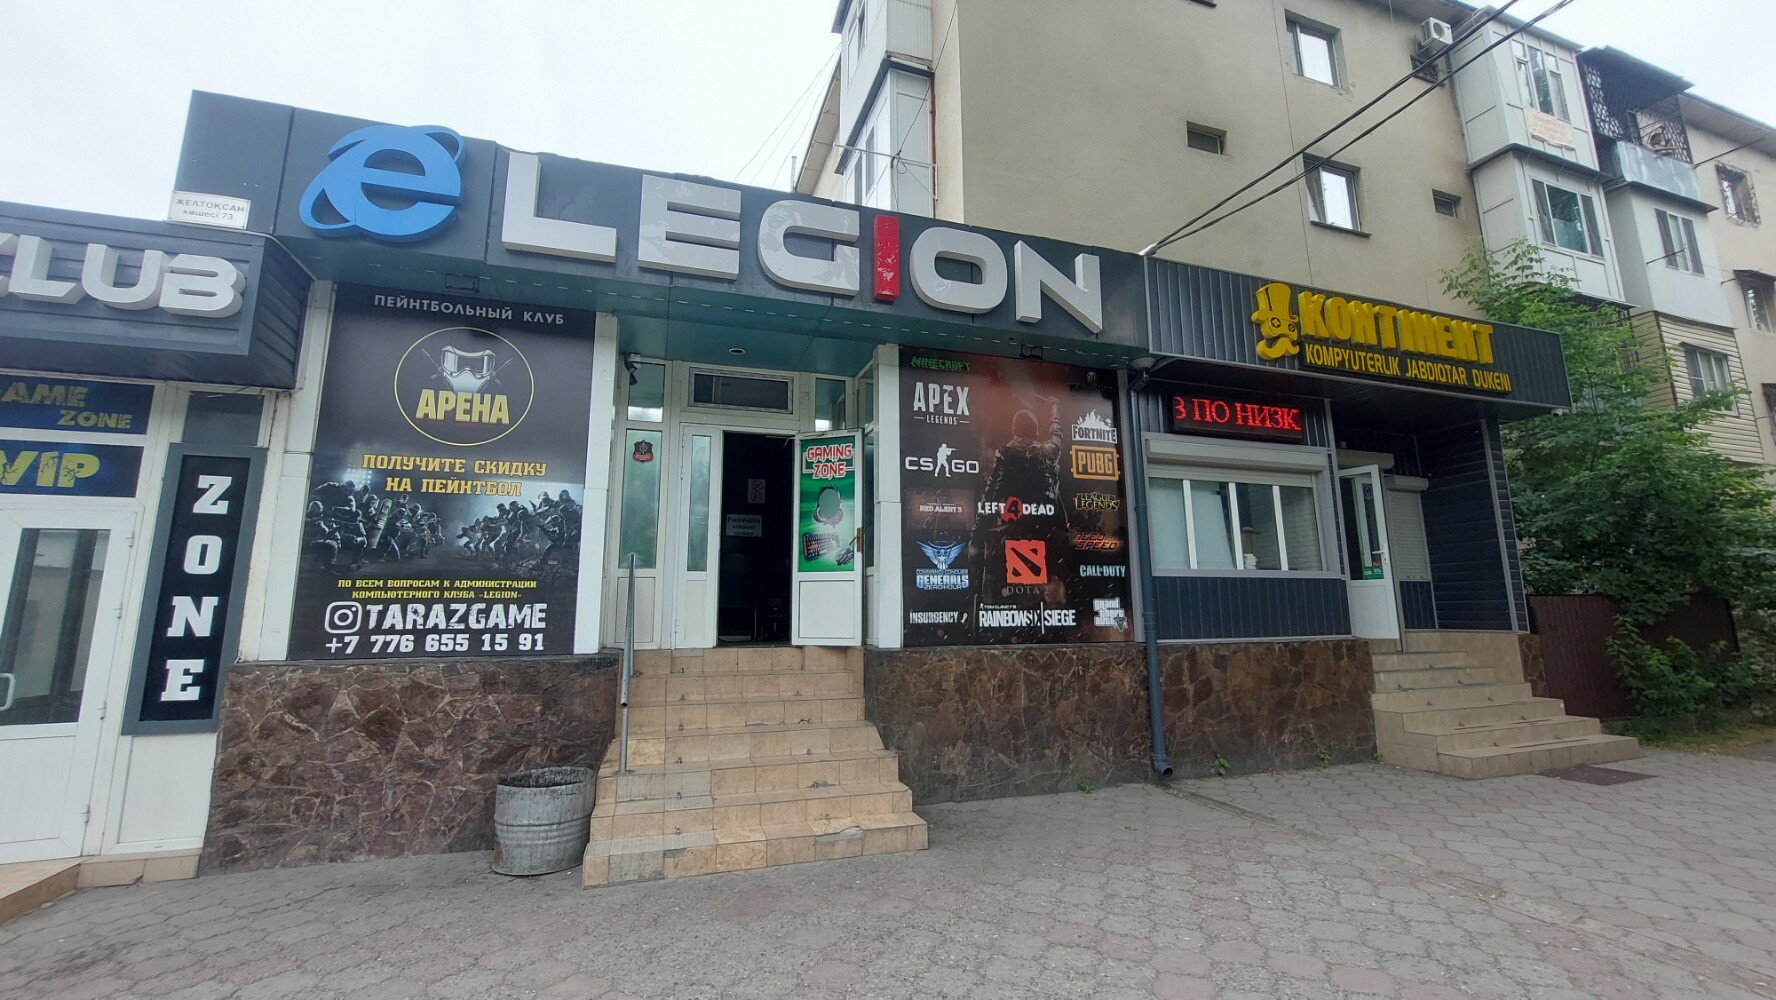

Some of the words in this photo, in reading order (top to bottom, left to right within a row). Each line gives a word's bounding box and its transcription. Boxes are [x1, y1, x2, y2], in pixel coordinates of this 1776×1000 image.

[222, 212, 234, 220] 73
[501, 151, 1103, 334] LEGION
[374, 294, 513, 321] ПЕЙНТБОЛЬНЫЙ
[523, 311, 565, 325] КЛУБ
[1305, 343, 1401, 376] KOMPYUTERLIK
[1405, 358, 1468, 386] JABDIQTAR
[1472, 368, 1512, 392] DUKENI
[415, 388, 511, 425] АРЕНА
[913, 382, 970, 416] APEX
[57, 409, 133, 429] ZONE
[926, 414, 958, 425] LEGENDS
[1191, 398, 1231, 423] ПО
[1234, 402, 1302, 430] НИЗК
[1072, 425, 1117, 443] FORTNITE
[806, 443, 853, 462] GAMING
[0, 449, 101, 489] VIP
[362, 454, 466, 473] ПОЛУЧИТЕ
[474, 460, 547, 477] СКИДКУ
[812, 462, 846, 479] ZONE
[1077, 451, 1113, 475] PUBG
[385, 477, 412, 493] НА
[421, 476, 523, 497] ПЕЙНТБОЛ
[977, 501, 1006, 515] LEFT
[1022, 502, 1055, 516] DEAD
[1073, 498, 1120, 511] LEGENDS
[1080, 564, 1102, 577] CALL
[1103, 565, 1126, 577] DUTY
[160, 474, 234, 702] ZONE
[338, 580, 352, 588] ПО
[355, 580, 383, 588] ВСЕМ
[387, 580, 440, 588] ВОПРОСАМ
[443, 580, 450, 588] К
[916, 574, 969, 588] GENERALS
[1007, 585, 1040, 595] DOTA
[352, 590, 440, 599] КОМПЬЮТЕРНОГО
[443, 590, 475, 599] КЛУБА
[366, 603, 548, 630] TARAZGAME
[909, 611, 959, 624] INSURGENCY
[979, 610, 1027, 627] RAINBOW
[1044, 609, 1077, 626] SIEGE
[325, 636, 360, 654] +7
[370, 635, 415, 653] 776
[425, 634, 470, 652] 655
[481, 633, 509, 651] 15
[518, 633, 544, 651] 91
